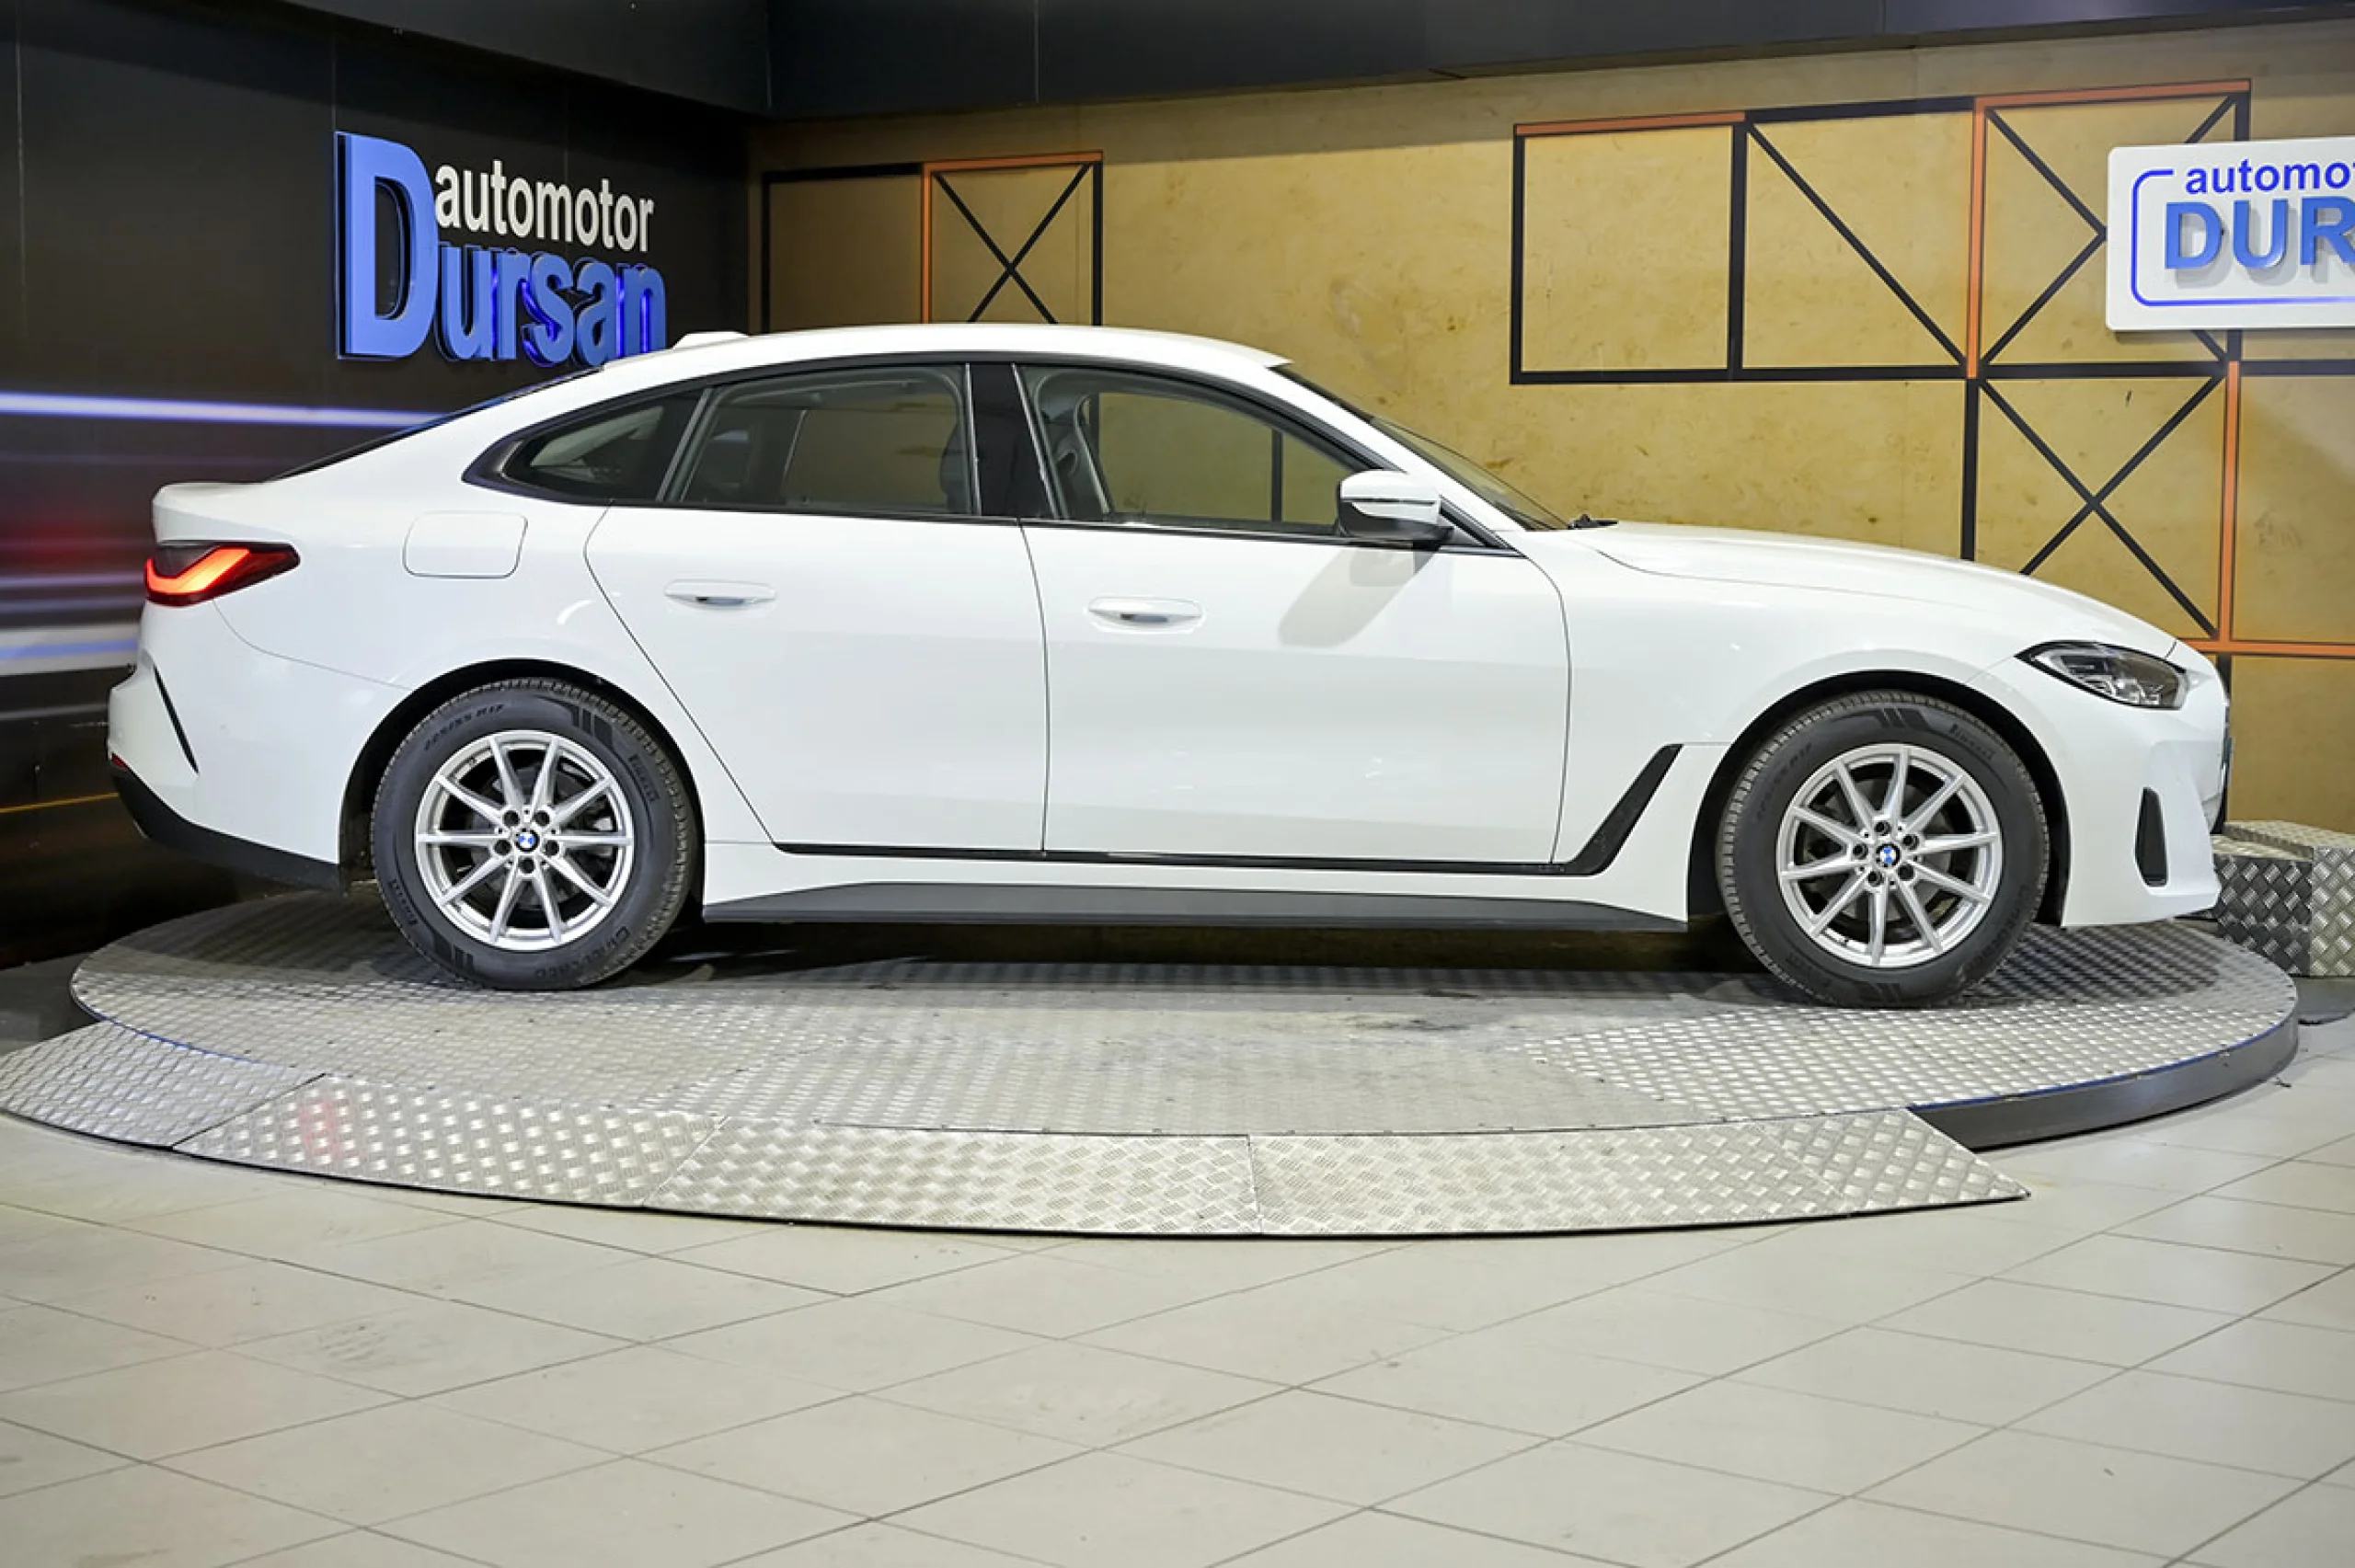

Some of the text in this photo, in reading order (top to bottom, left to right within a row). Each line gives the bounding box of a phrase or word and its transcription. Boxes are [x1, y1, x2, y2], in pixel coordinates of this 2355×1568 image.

[435, 160, 654, 253] automotor
[2186, 159, 2355, 194] automo
[335, 131, 667, 367] Dursan
[2165, 196, 2355, 269] DUR
